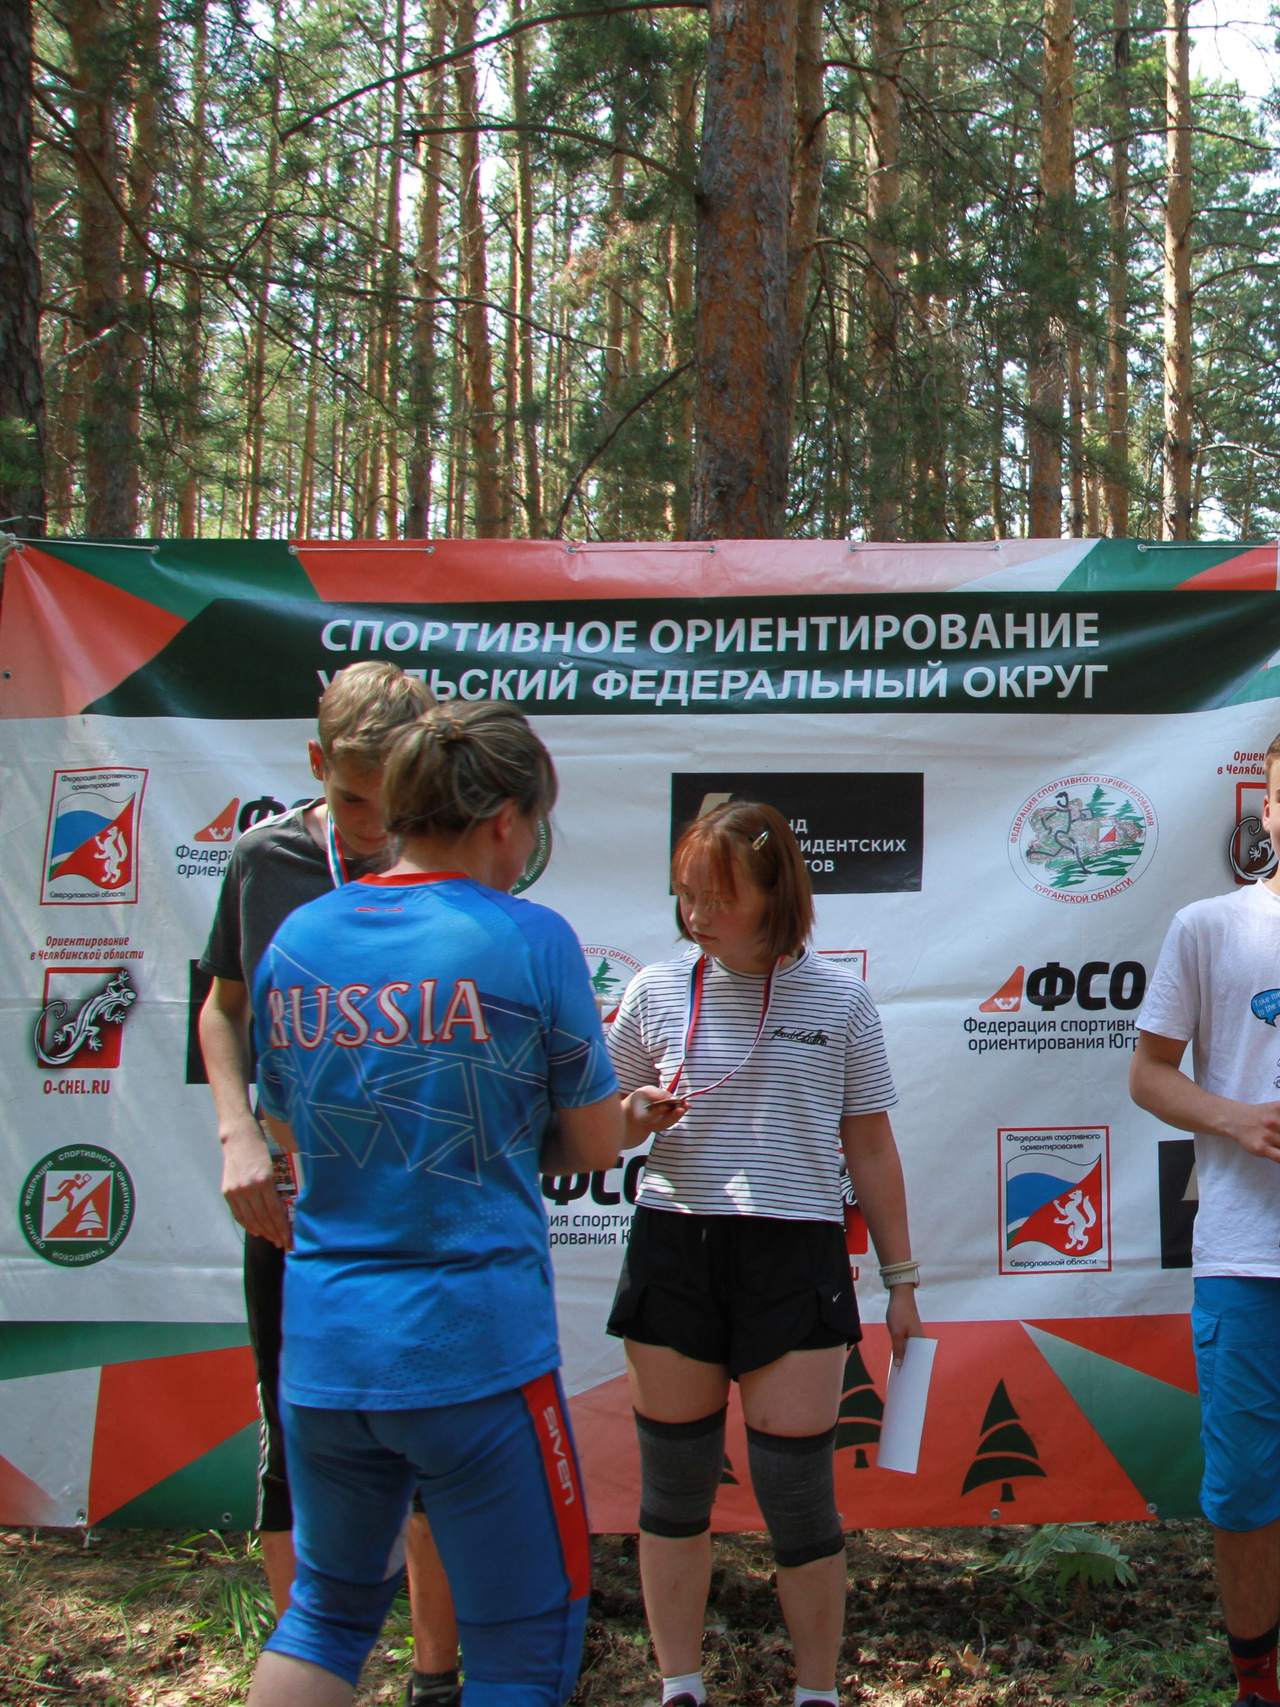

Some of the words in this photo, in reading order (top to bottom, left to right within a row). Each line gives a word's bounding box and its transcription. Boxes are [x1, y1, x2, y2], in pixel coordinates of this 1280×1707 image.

[320, 619, 638, 654] СПОРТИВНОЕ
[648, 612, 1100, 654] ОРИЕНТИРОВАНИЕ
[591, 660, 949, 707] ФЕДЕРАЛЬНЫЙ
[961, 664, 1109, 699] ОКРУГ
[1233, 750, 1265, 763] Ориен
[1217, 766, 1223, 775] в
[1010, 796, 1039, 844] ФЕДЕРАЦИЯ
[1038, 776, 1100, 799] СПОРТИВНОГО
[1101, 776, 1155, 827] ОРИЕНТИРОВАНИЯ
[797, 839, 907, 854] ИДЕНТСКИХ
[176, 864, 227, 878] ориен
[1033, 883, 1089, 903] КУРГАНСКОЙ
[1090, 877, 1133, 901] ОБЛАСТИ
[45, 935, 130, 949] Ориентирование
[30, 952, 36, 961] в
[38, 948, 102, 960] Челябинской
[103, 949, 145, 960] области
[582, 947, 607, 955] НОГО
[1026, 960, 1147, 1012] ФСО
[1253, 996, 1270, 1007] Take
[1265, 1003, 1277, 1012] the
[268, 978, 492, 1050] RUSSIA
[963, 1017, 1056, 1036] Федерация
[968, 1037, 1105, 1054] ориентирования
[43, 1079, 111, 1095] O-CHEL.RU
[1006, 1134, 1053, 1143] Федерация
[1054, 1133, 1101, 1141] спортивного
[1020, 1143, 1084, 1152] ориентирования
[24, 1160, 55, 1207] ФЕДЕРАЦИЯ
[58, 1149, 116, 1169] СПОРТИВНОГО
[108, 1171, 131, 1247] ОРИЕНТИРОВАНИЯ
[549, 1232, 617, 1248] рования
[1010, 1259, 1065, 1269] Свердловской
